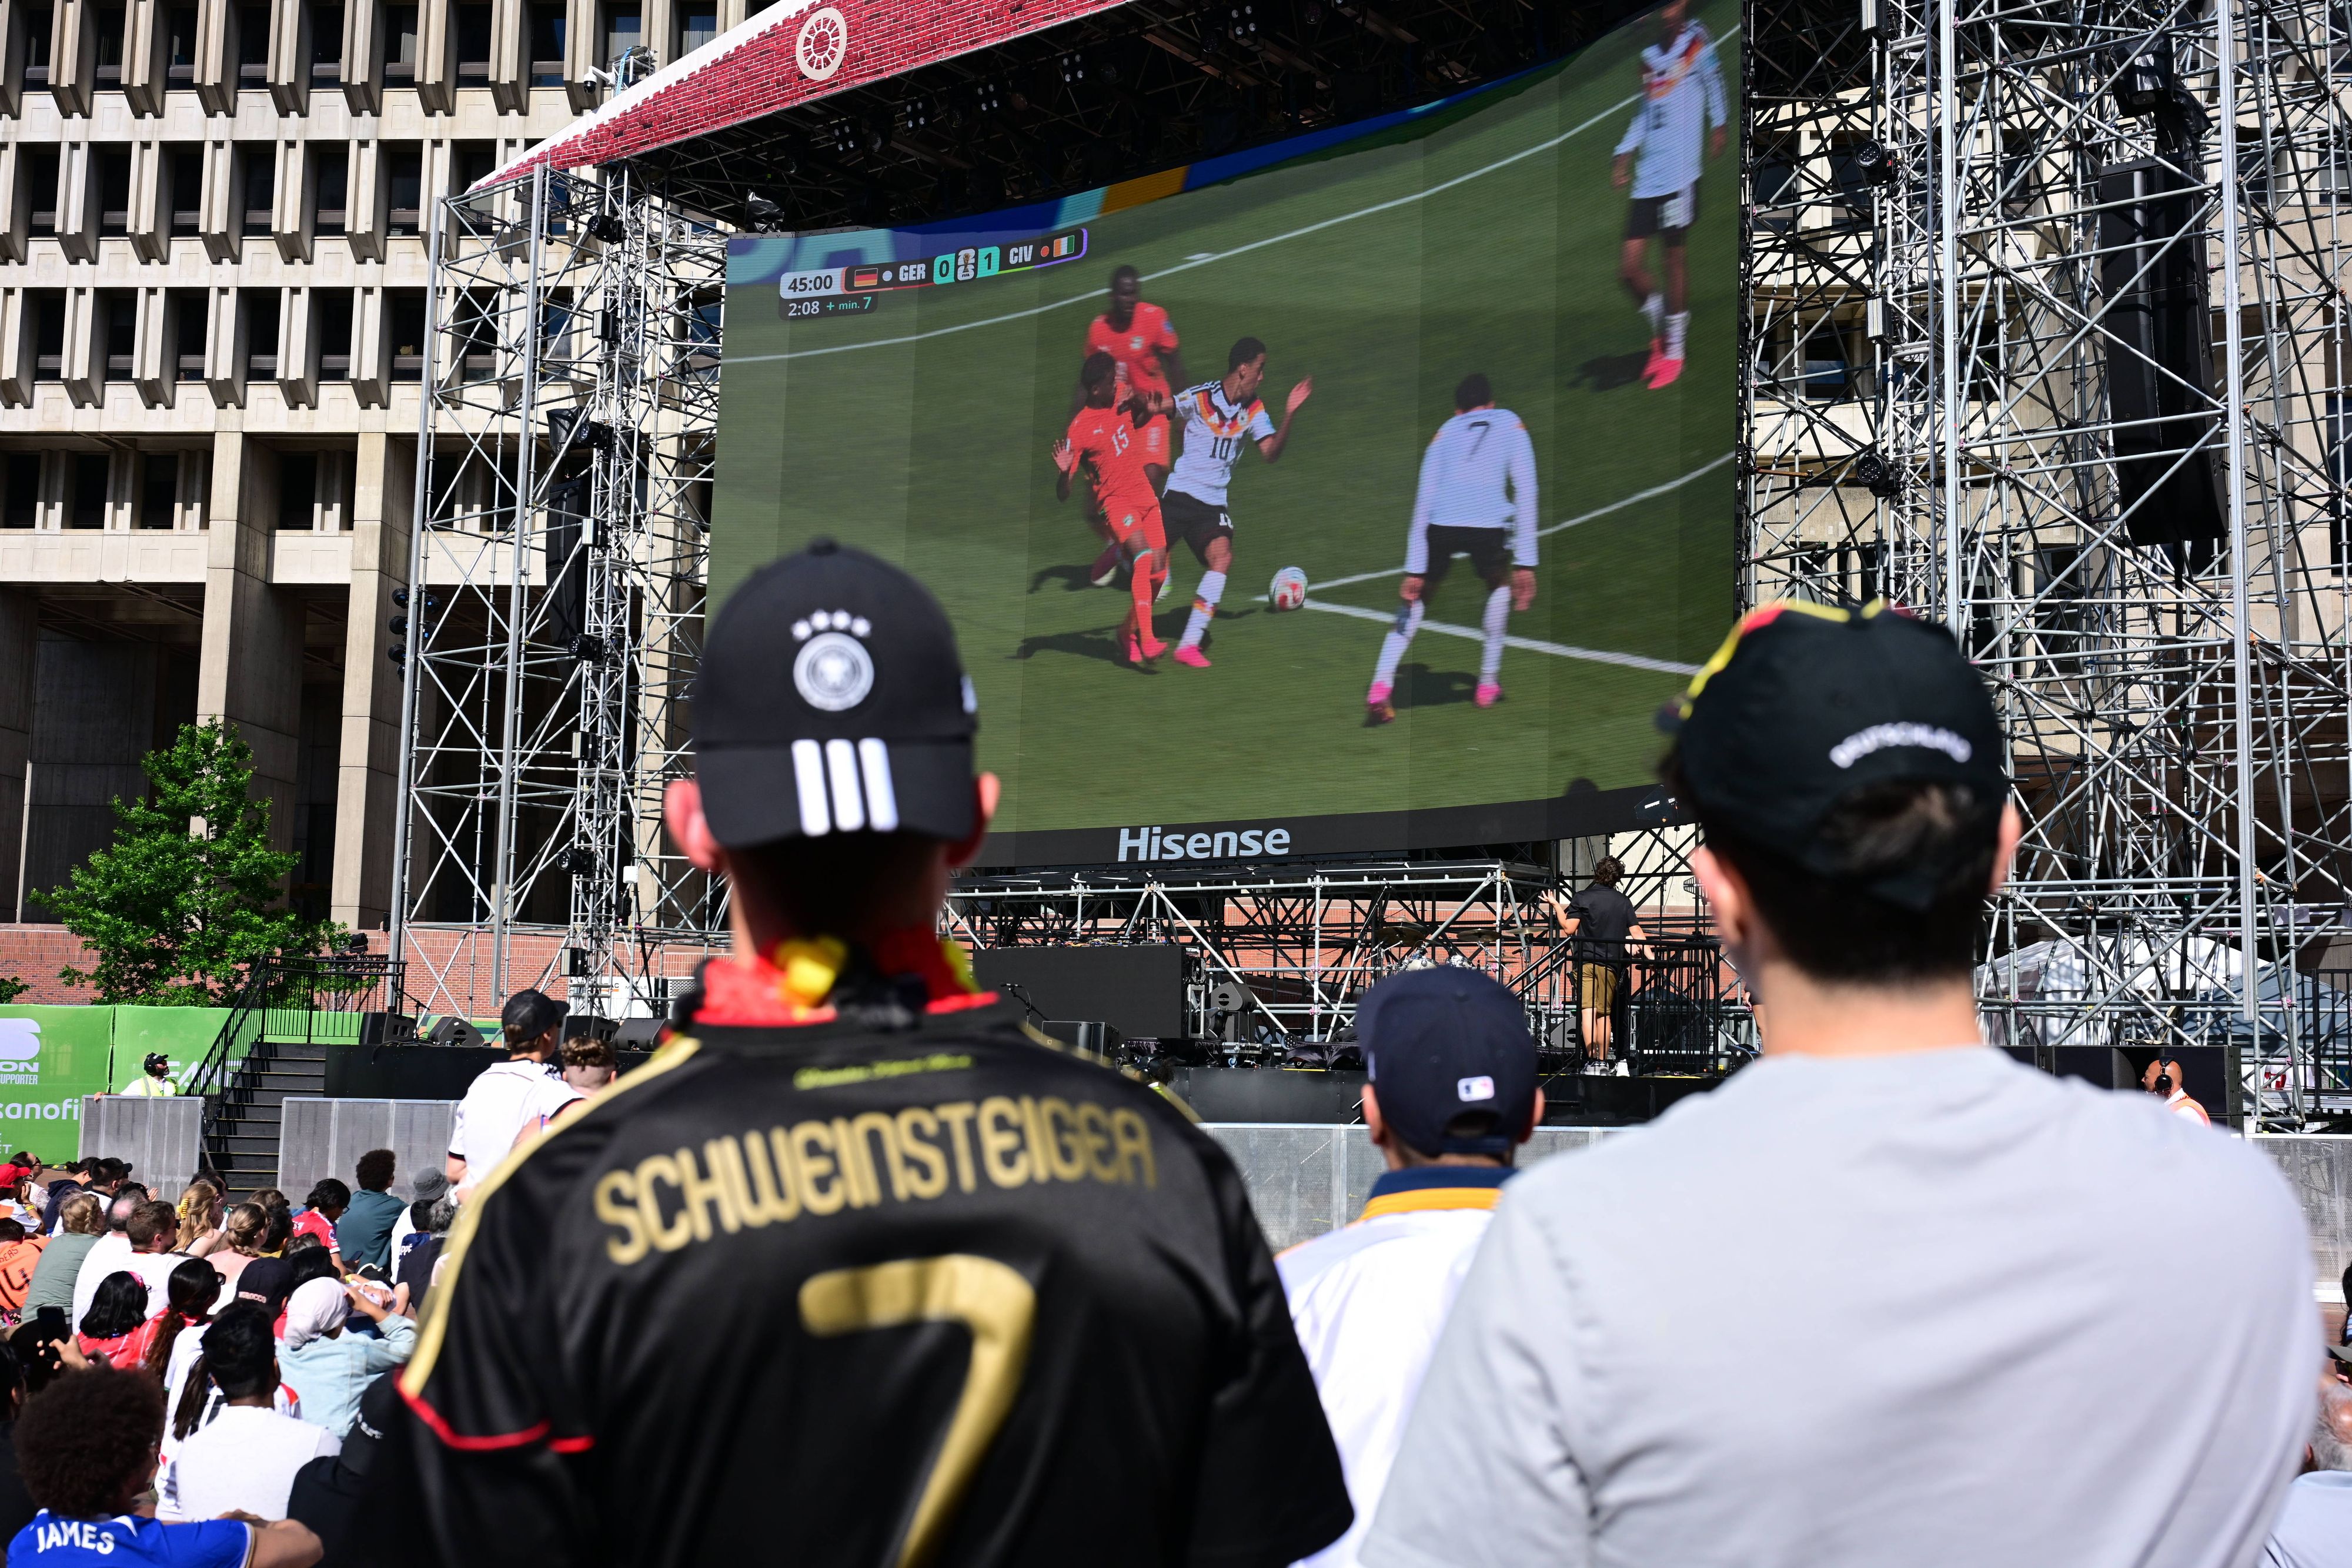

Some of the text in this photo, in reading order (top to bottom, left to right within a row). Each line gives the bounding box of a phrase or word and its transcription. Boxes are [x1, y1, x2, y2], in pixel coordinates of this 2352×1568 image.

[984, 245, 1033, 270] 1 CIV
[788, 275, 833, 292] 45:00
[899, 260, 950, 282] GER 0
[788, 301, 820, 316] 2:08
[838, 300, 860, 310] min.
[863, 296, 872, 309] 7
[1111, 423, 1129, 457] 15
[1209, 437, 1232, 461] 10
[1469, 421, 1491, 460] 7
[1118, 826, 1290, 862] Hisense
[0, 1074, 38, 1085] UPPORTER
[797, 1252, 1035, 1568] 7
[36, 1521, 115, 1554] JAMES
